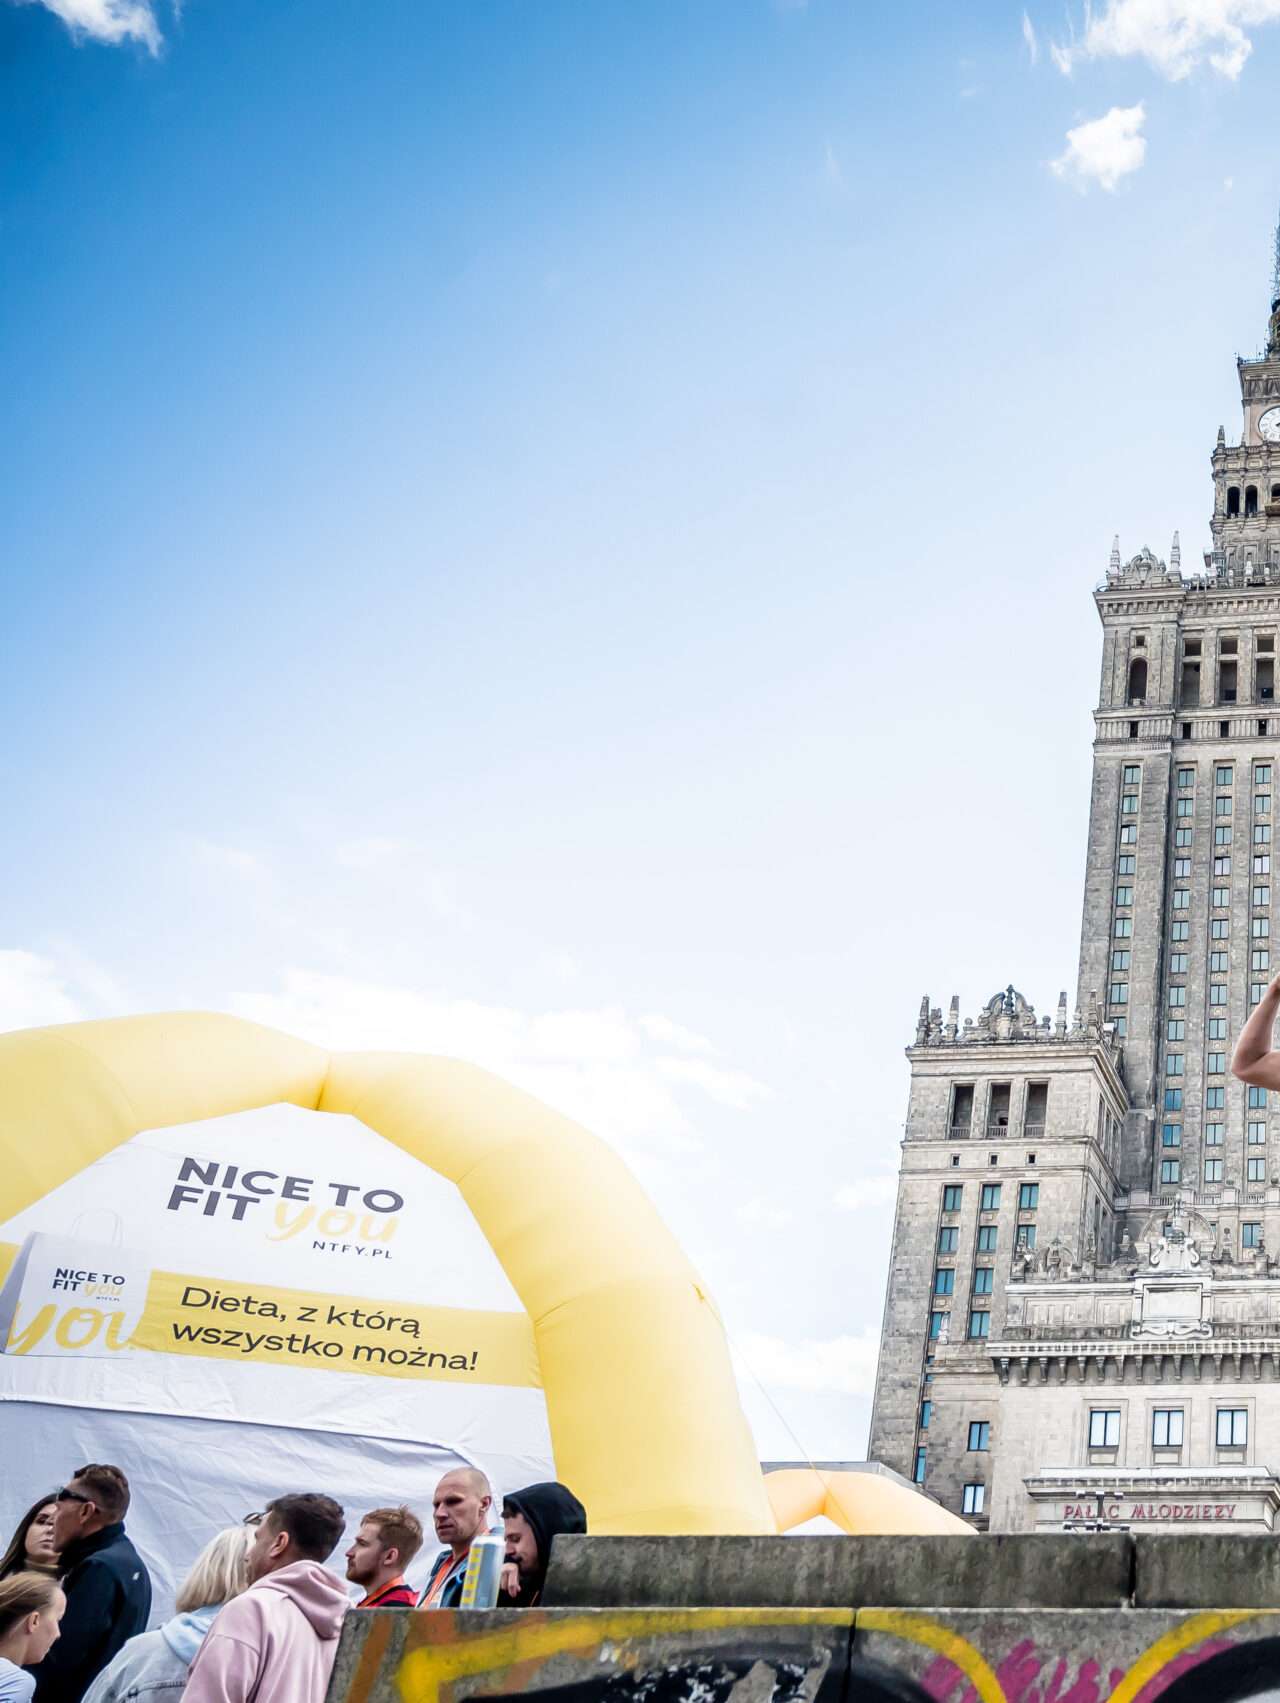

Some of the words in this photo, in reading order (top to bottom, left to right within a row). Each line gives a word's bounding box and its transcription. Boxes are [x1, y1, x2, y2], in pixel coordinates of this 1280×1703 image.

[177, 1157, 314, 1202] NICE
[329, 1183, 404, 1213] TO
[167, 1184, 260, 1221] FIT
[265, 1200, 400, 1243] you
[312, 1240, 393, 1259] NTFY.PL
[52, 1279, 81, 1291] FIT
[55, 1267, 98, 1283] NICE
[102, 1274, 126, 1286] TO
[180, 1286, 287, 1322] Dieta,
[296, 1306, 318, 1322] z
[327, 1305, 421, 1339] którą
[172, 1322, 344, 1357] wszystko
[352, 1345, 478, 1371] można!
[1130, 1503, 1237, 1519] MŁODZIEŻY
